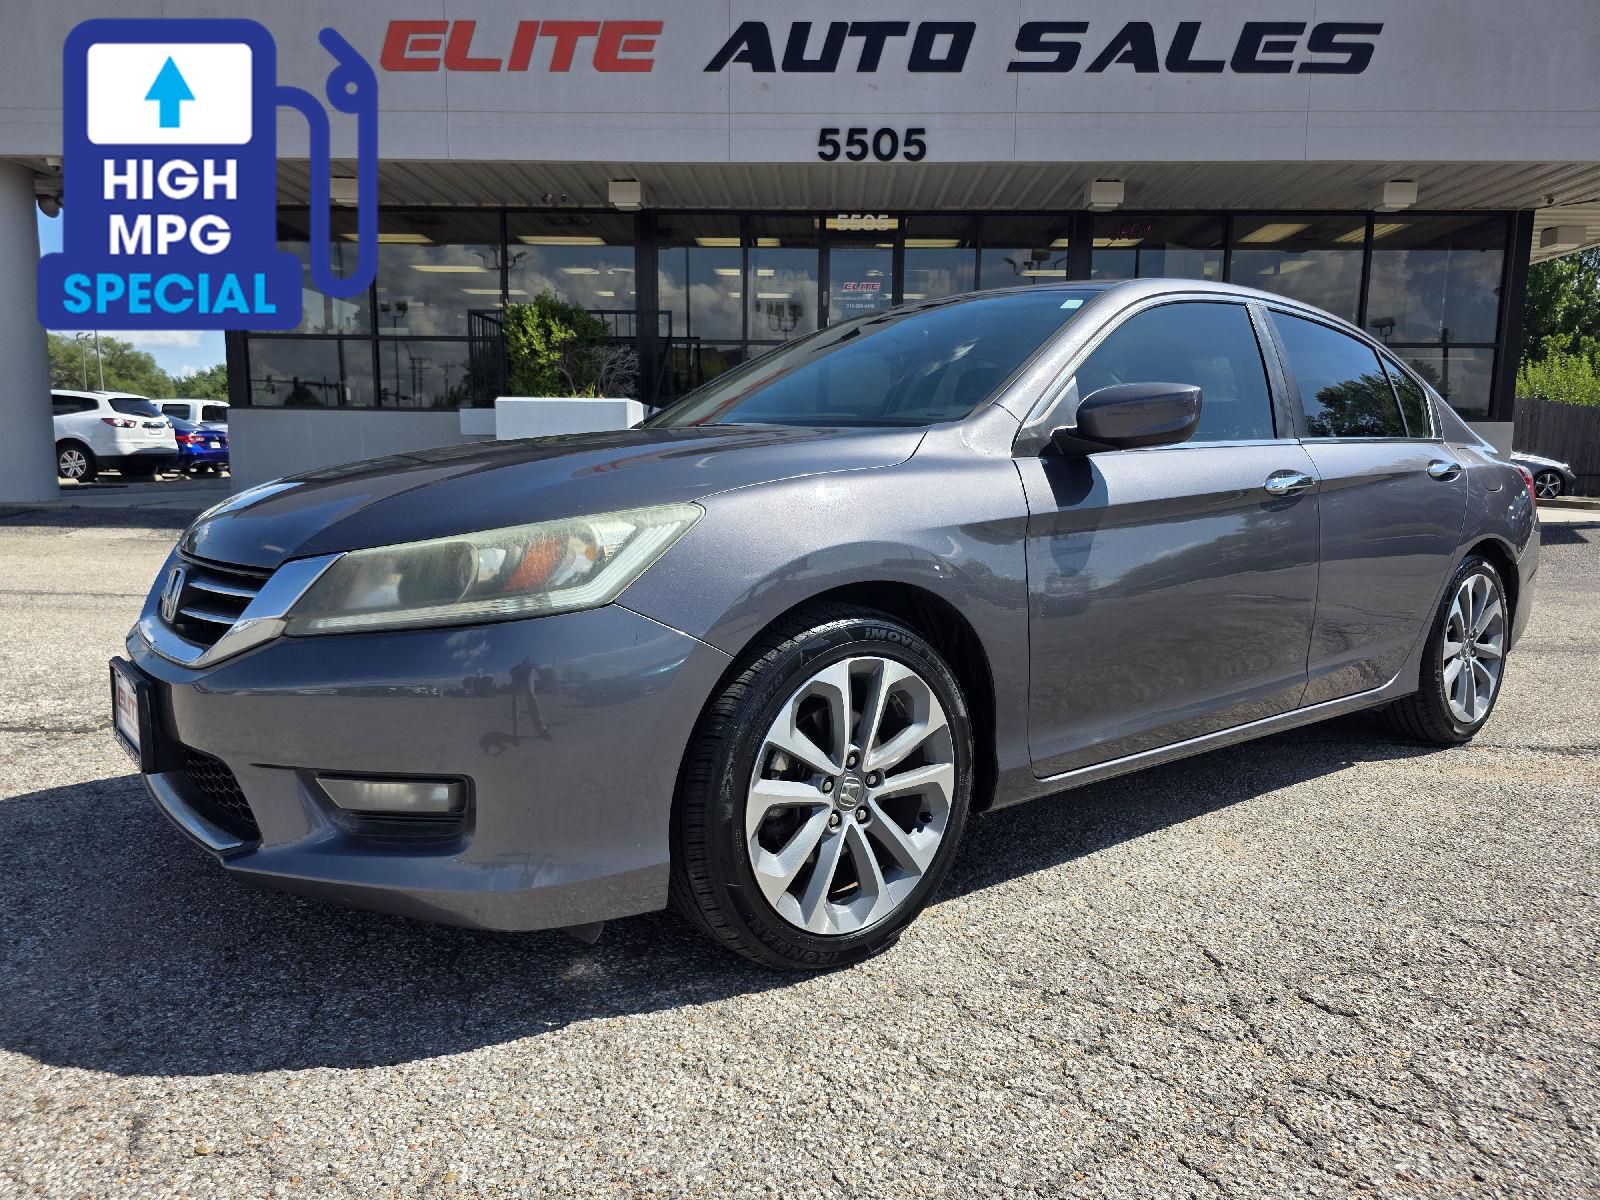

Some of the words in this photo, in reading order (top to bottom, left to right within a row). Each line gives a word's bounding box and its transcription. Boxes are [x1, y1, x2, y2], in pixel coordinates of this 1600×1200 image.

[380, 20, 662, 73] ELITE
[703, 21, 977, 73] AUTO
[1007, 21, 1385, 75] SALES
[817, 126, 928, 163] 5505
[836, 214, 889, 231] 5505
